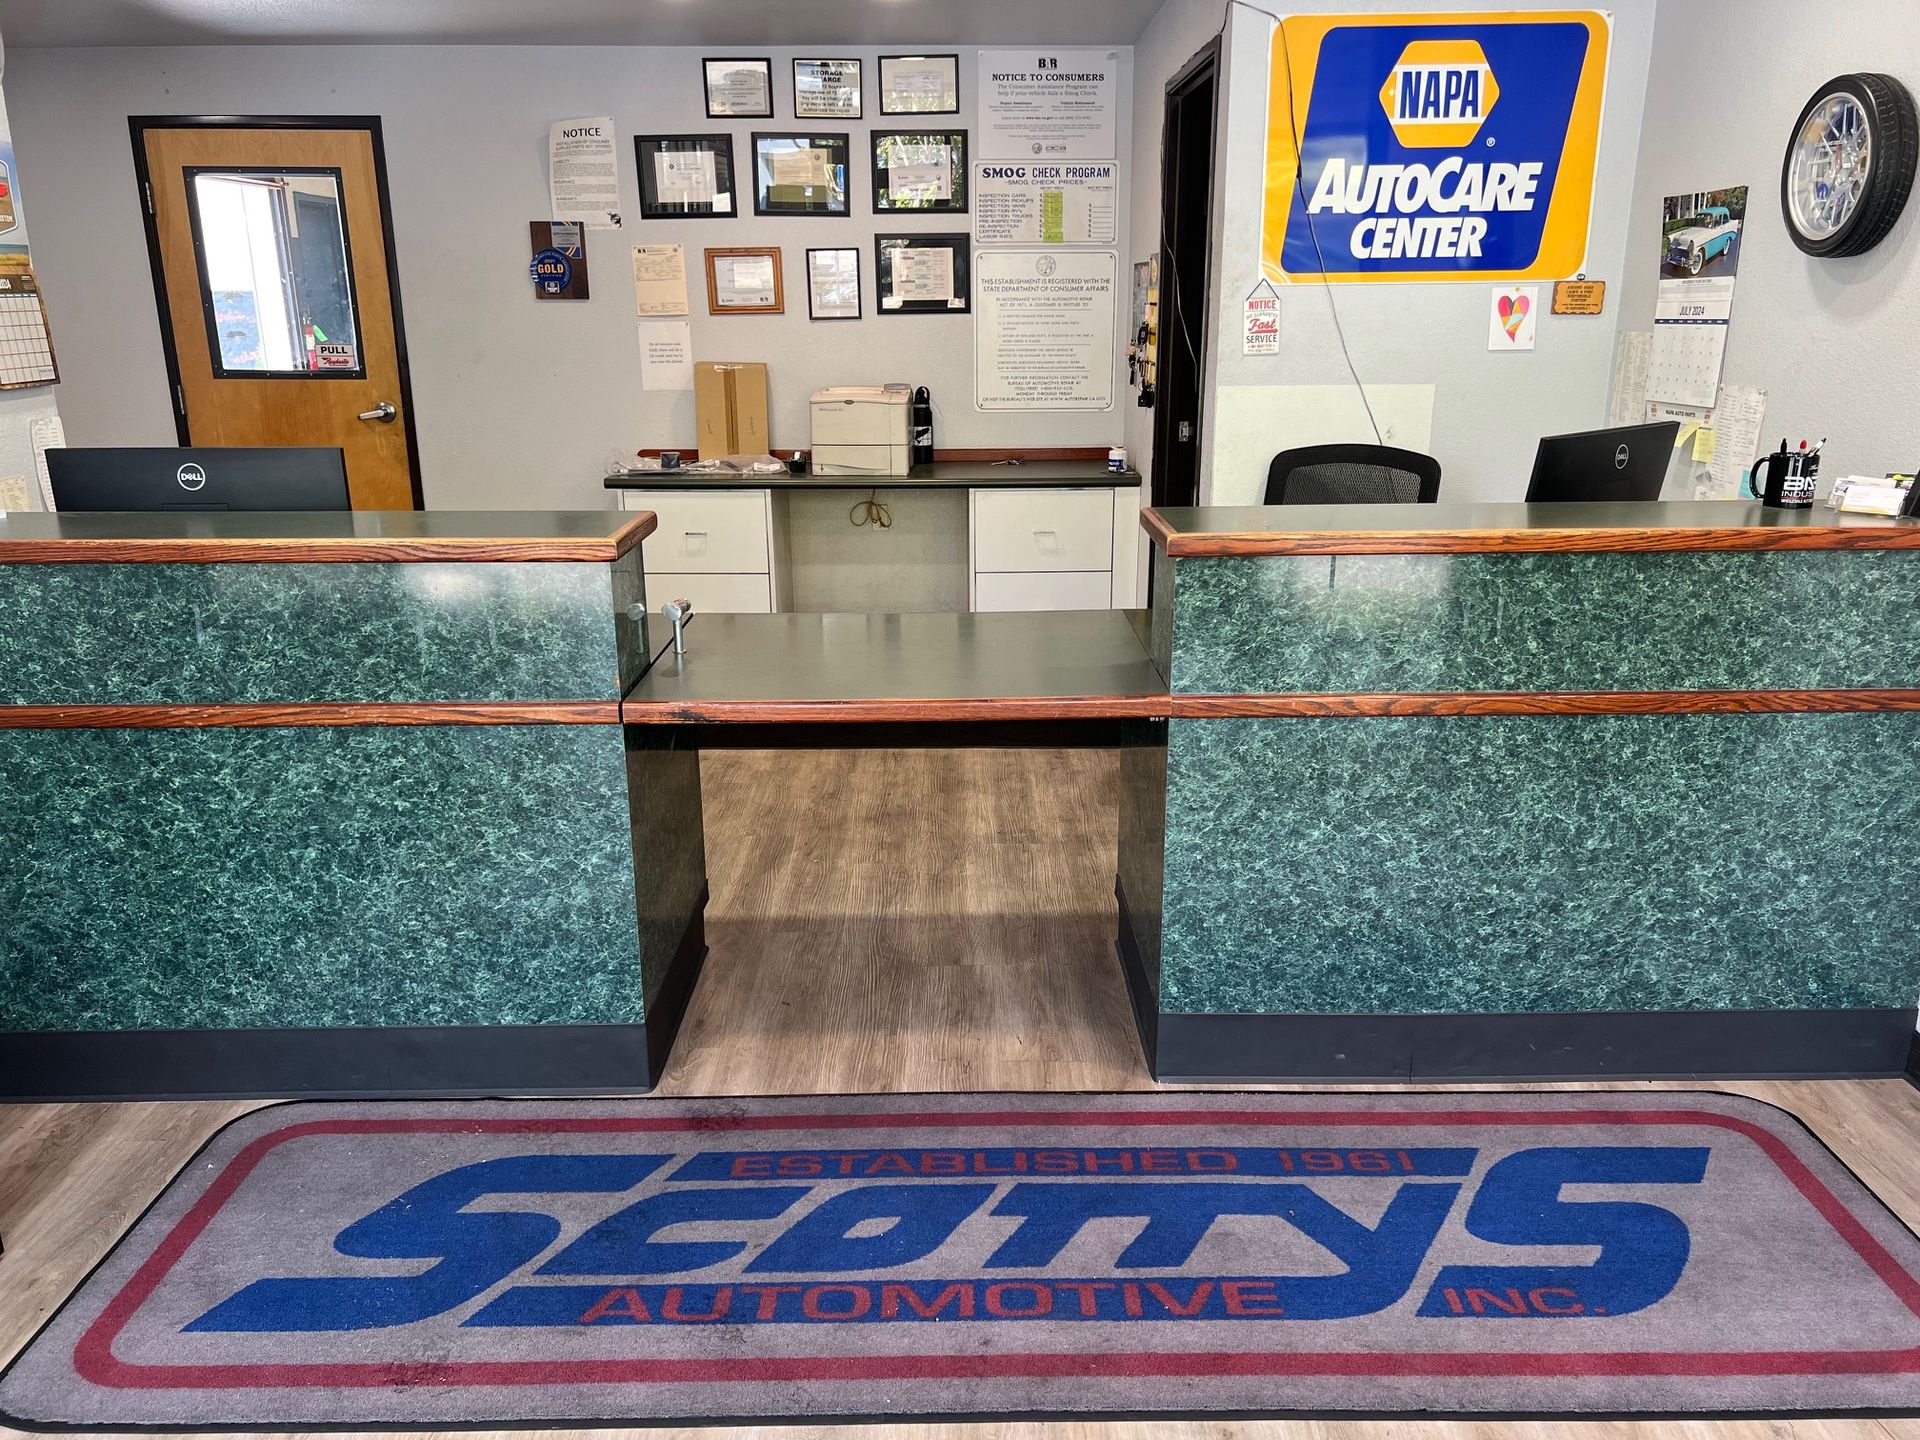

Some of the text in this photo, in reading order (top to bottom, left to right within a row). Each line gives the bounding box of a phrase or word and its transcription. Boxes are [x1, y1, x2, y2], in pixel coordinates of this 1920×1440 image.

[992, 73, 1105, 81] NOTICE TO CONSUMERS
[1399, 70, 1479, 119] NAPA
[563, 127, 602, 138] NOTICE
[982, 167, 1110, 179] SMOG CHECK PROGRAM
[1306, 156, 1543, 215] AUTOCARE
[1350, 216, 1487, 259] CENTER
[537, 264, 564, 273] GOLD
[1248, 300, 1276, 310] NOTICE
[1680, 306, 1705, 316] JULY 2024
[1248, 318, 1277, 331] Fast
[1246, 334, 1277, 344] SERVICE
[320, 346, 348, 354] PULL
[180, 473, 202, 481] DELL
[730, 1150, 1414, 1178] ESTABLISHED 1961
[579, 1279, 1606, 1325] AUTOMOTIVE INC.
